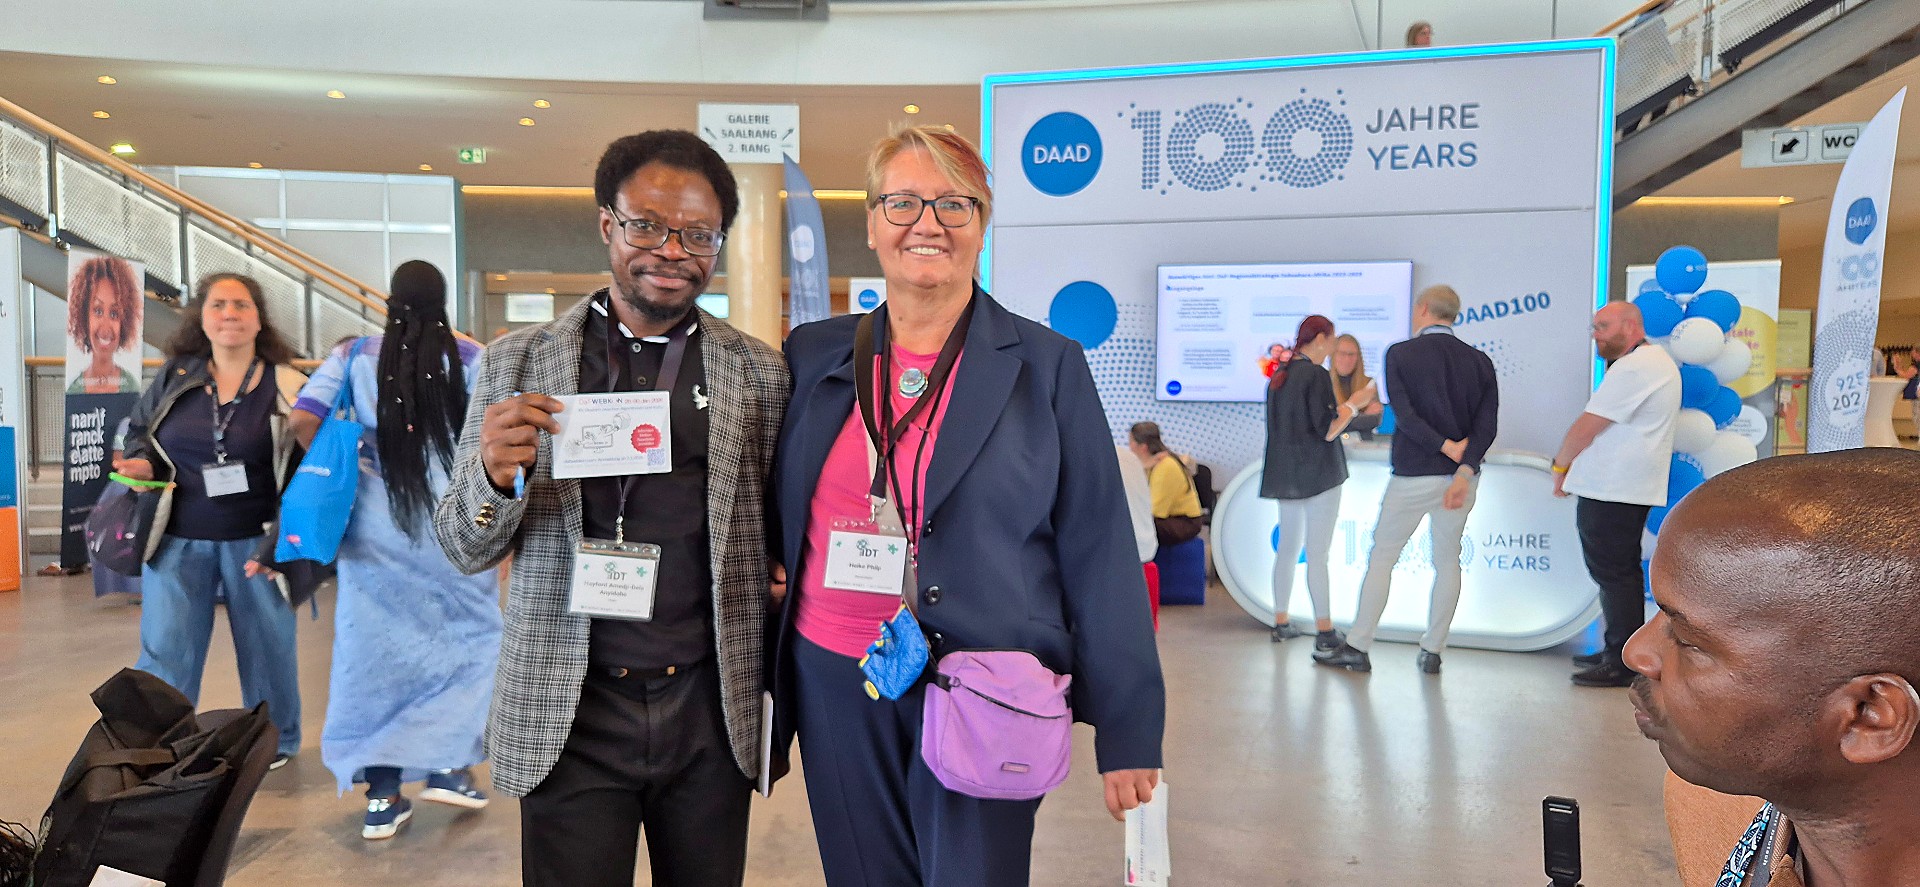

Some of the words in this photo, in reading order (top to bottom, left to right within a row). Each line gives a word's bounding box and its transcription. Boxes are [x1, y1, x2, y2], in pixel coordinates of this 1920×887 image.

[728, 114, 770, 125] GALERIE
[1366, 103, 1480, 135] JAHRE
[721, 128, 777, 139] SAALRANG
[1824, 134, 1856, 150] WC
[741, 143, 771, 154] RANG
[1131, 98, 1353, 192] 100
[1033, 143, 1091, 165] DAAD
[1366, 142, 1480, 171] YEARS
[1482, 533, 1551, 550] JAHRE
[1483, 554, 1551, 571] YEARS
